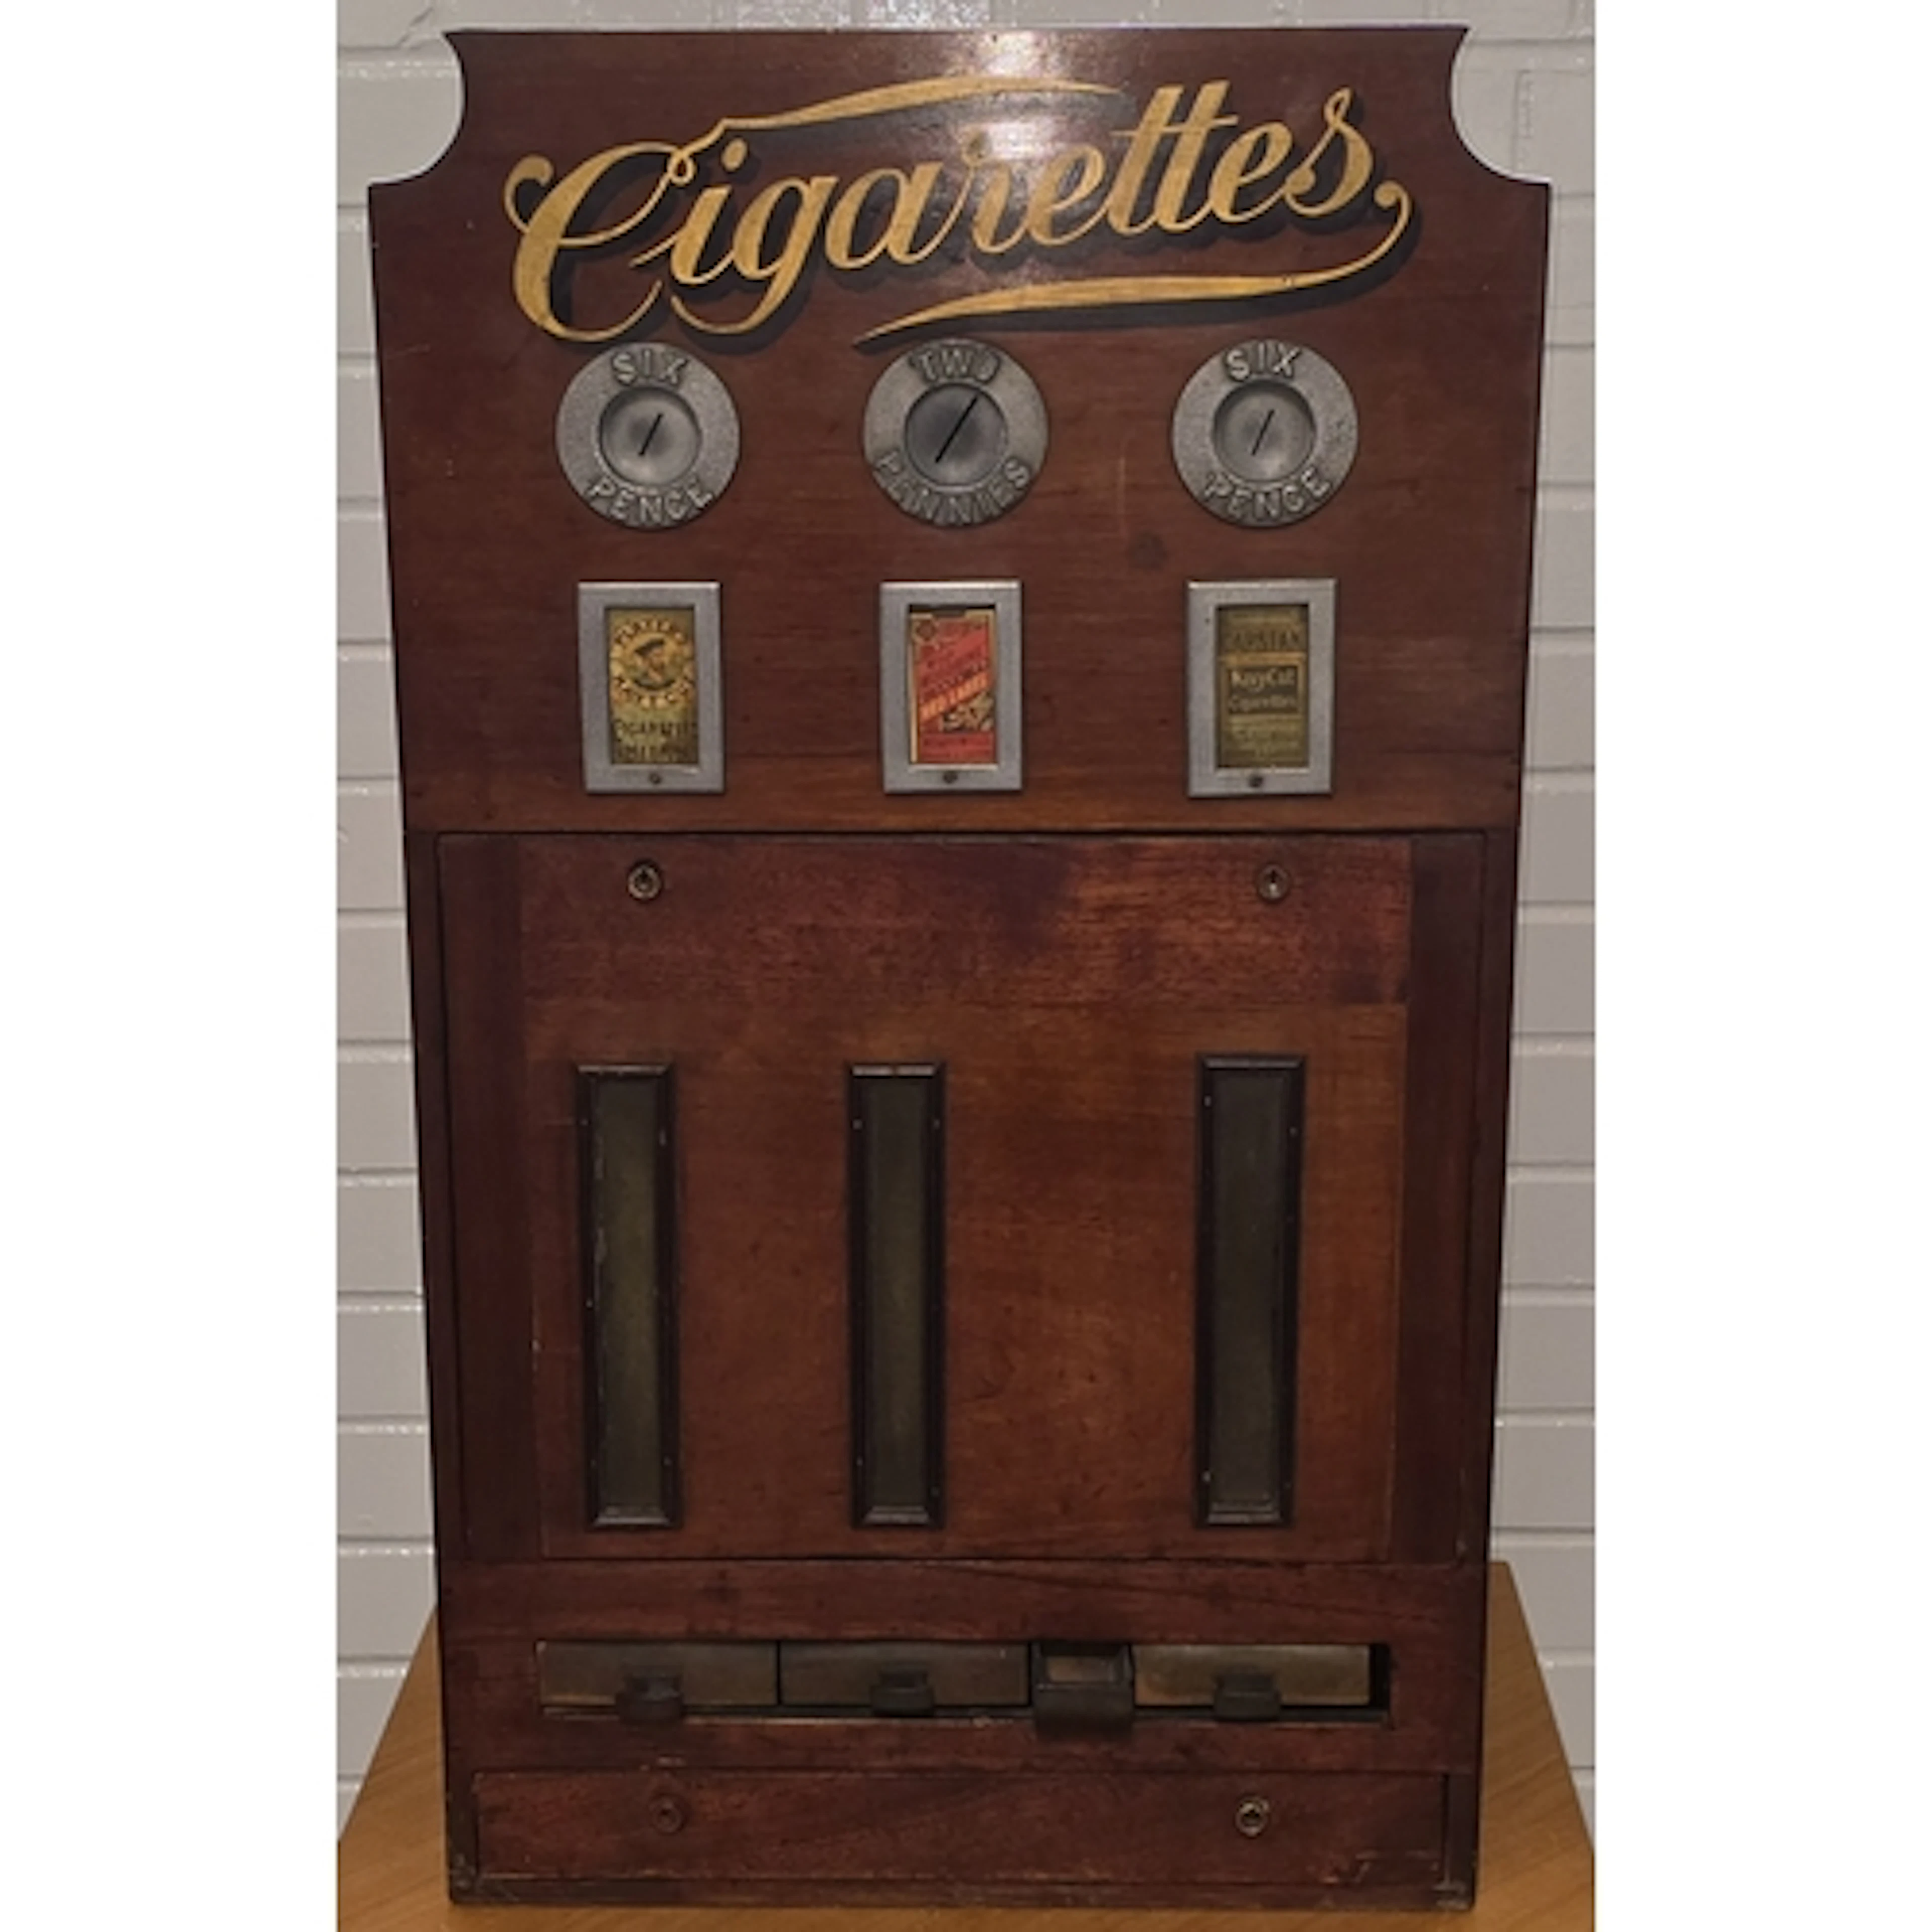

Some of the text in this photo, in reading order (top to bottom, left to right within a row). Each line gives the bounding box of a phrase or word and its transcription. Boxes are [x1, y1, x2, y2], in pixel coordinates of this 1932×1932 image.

[504, 71, 1375, 342] Cigarettes
[612, 349, 689, 386] SIX
[910, 349, 1001, 383] TWO
[1225, 343, 1302, 381] SIX
[587, 474, 714, 523] PENCE
[872, 451, 1030, 526] PENNIES
[1203, 466, 1332, 519] PENCE
